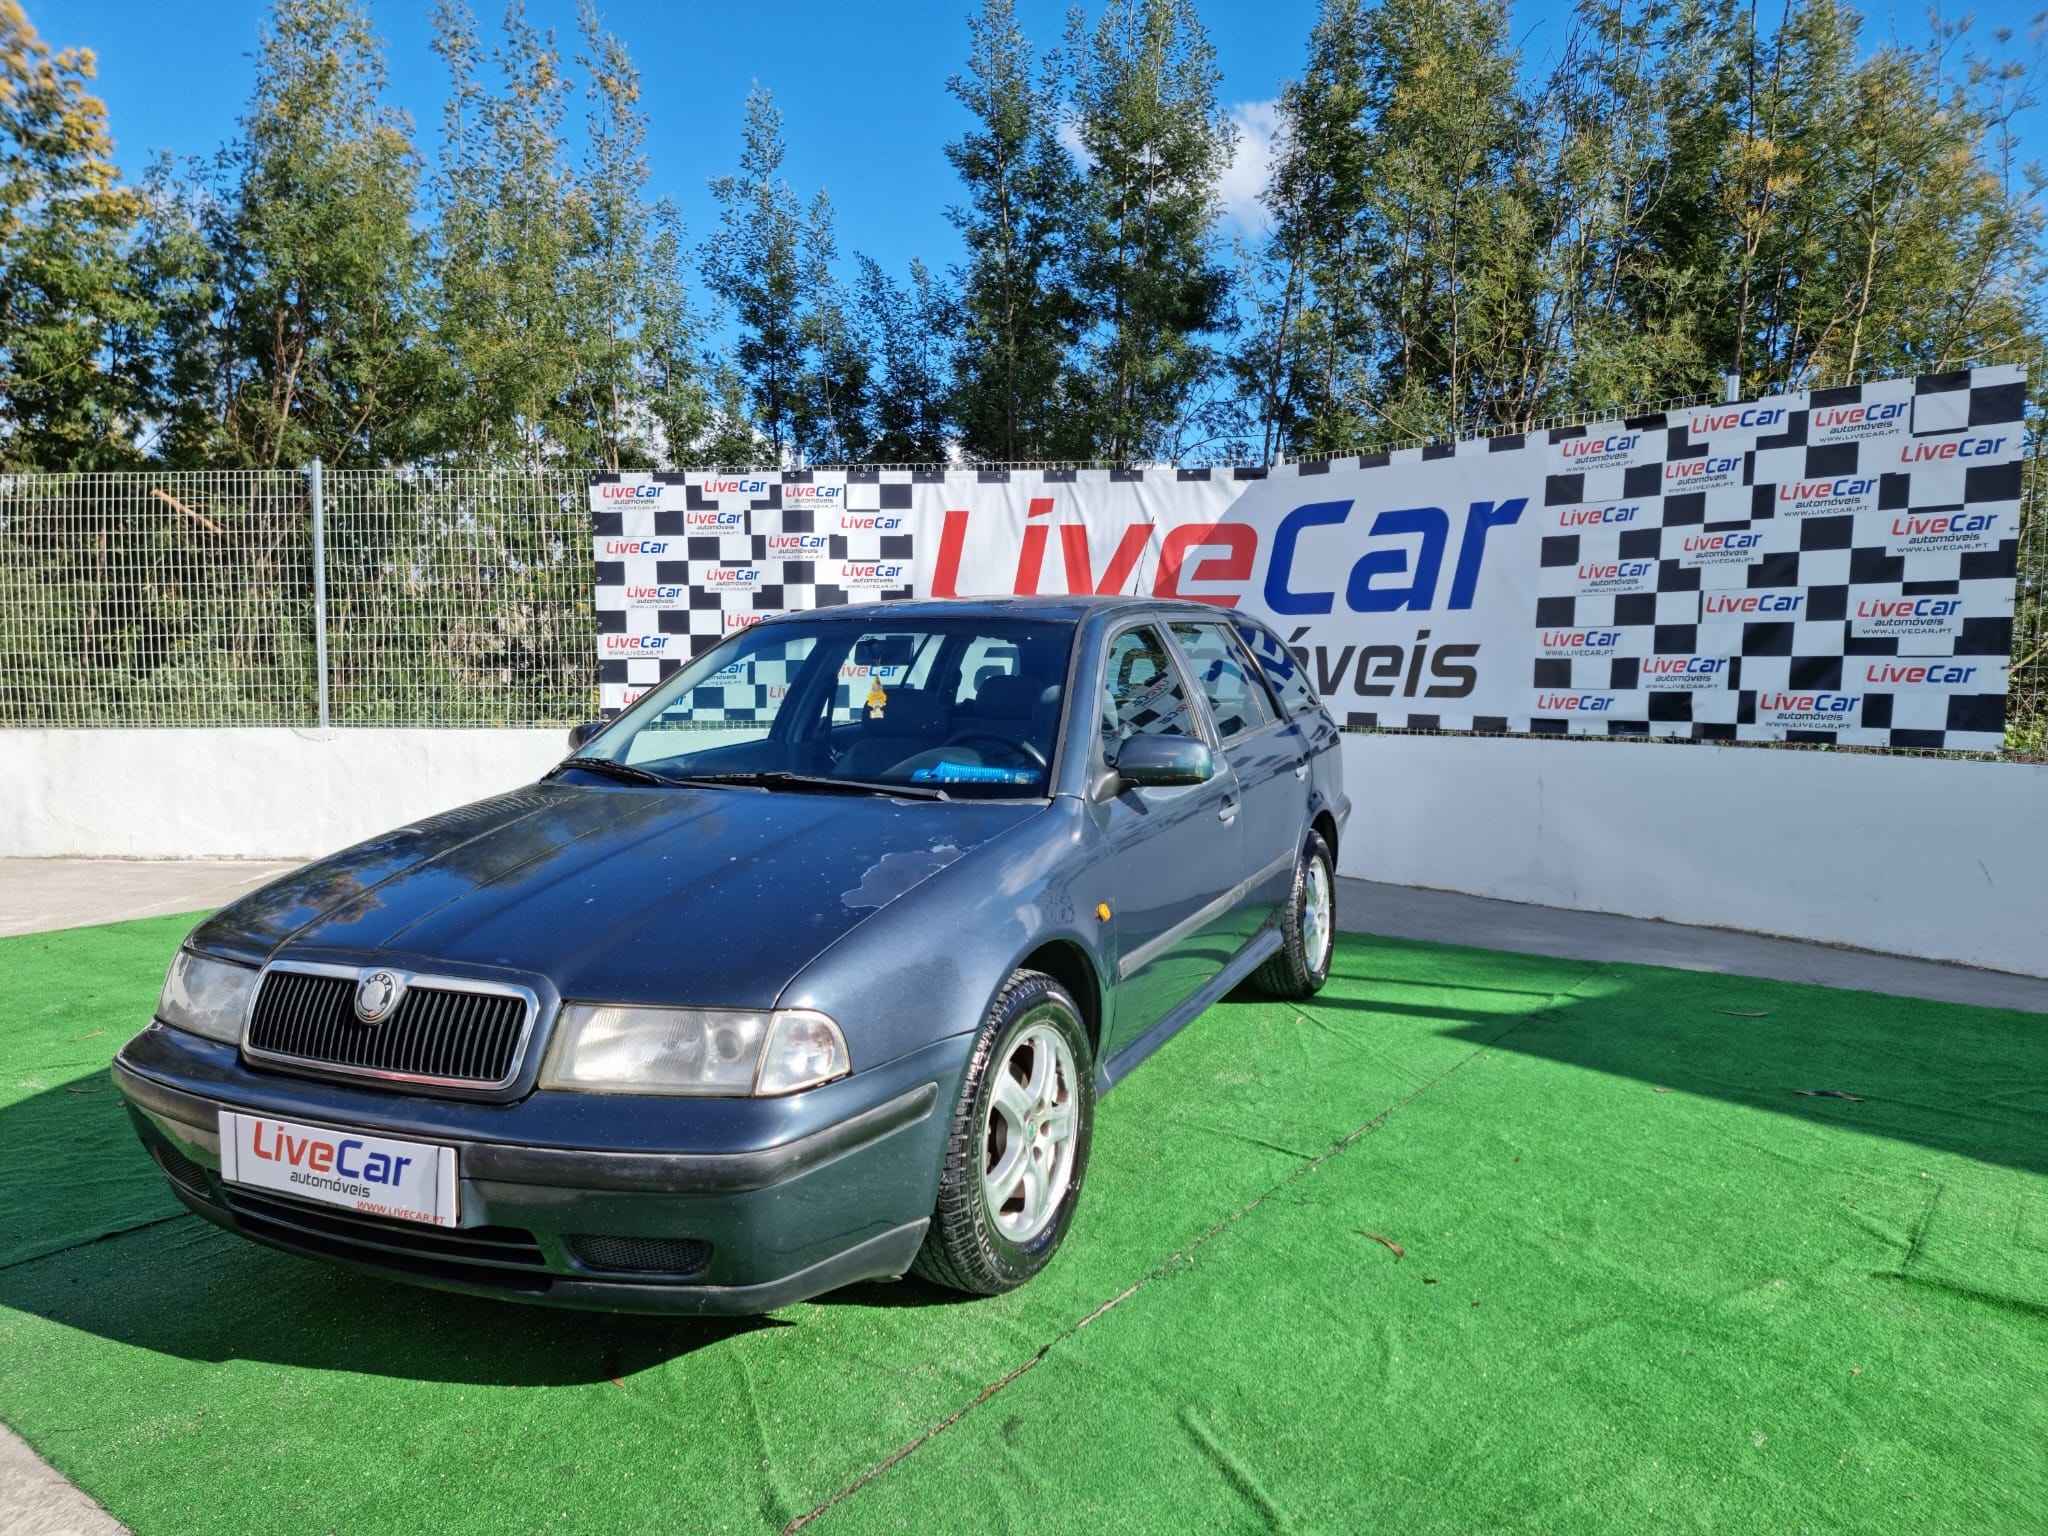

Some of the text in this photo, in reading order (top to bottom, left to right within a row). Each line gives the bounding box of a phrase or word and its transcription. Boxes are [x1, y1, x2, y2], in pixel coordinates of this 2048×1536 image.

[1691, 408, 1786, 434] LiveCar
[1815, 402, 1908, 428] LiveCar
[1829, 420, 1893, 434] automóveis
[1562, 434, 1641, 458] LiveCar
[1901, 437, 2007, 463] LiveCar
[1574, 451, 1628, 465] automóveis
[1665, 456, 1743, 479] LiveCar
[704, 479, 767, 493] LiveCar
[1677, 474, 1728, 486] automóveis
[602, 485, 664, 499] LiveCar
[785, 484, 843, 498] LiveCar
[1780, 478, 1878, 501] LiveCar
[1795, 496, 1861, 509] automóveis
[686, 512, 743, 526] LiveCar
[840, 516, 902, 529] LiveCar
[1559, 505, 1640, 527] LiveCar
[1892, 513, 1999, 536] LiveCar
[768, 534, 828, 548] LiveCar
[1684, 533, 1763, 552] LiveCar
[1908, 532, 1980, 544] automóveis
[606, 540, 669, 554] LiveCar
[1695, 548, 1749, 559] automóveis
[931, 497, 1530, 615] LiveCar
[706, 569, 760, 581] LiveCar
[842, 563, 903, 578] LiveCar
[1578, 562, 1652, 580] LiveCar
[1590, 577, 1639, 587] automóveis
[626, 585, 682, 599] LiveCar
[1705, 593, 1804, 613] LiveCar
[1857, 599, 1962, 618] LiveCar
[727, 614, 771, 627] Live
[1874, 617, 1944, 627] automóveis
[606, 635, 669, 649] LiveCar
[1543, 630, 1622, 647] LiveCar
[1286, 626, 1481, 699] óveis
[1642, 657, 1727, 674] LiveCar
[1655, 674, 1712, 682] automóveis
[1866, 663, 1977, 683] LiveCar
[1537, 693, 1615, 711] LiveCar
[1760, 693, 1861, 712] LiveCar
[1776, 711, 1844, 721] automóveis
[253, 1120, 413, 1186] LiveCar
[290, 1170, 371, 1198] automóveis
[356, 1200, 446, 1225] WWW.LIVECAR.PT
